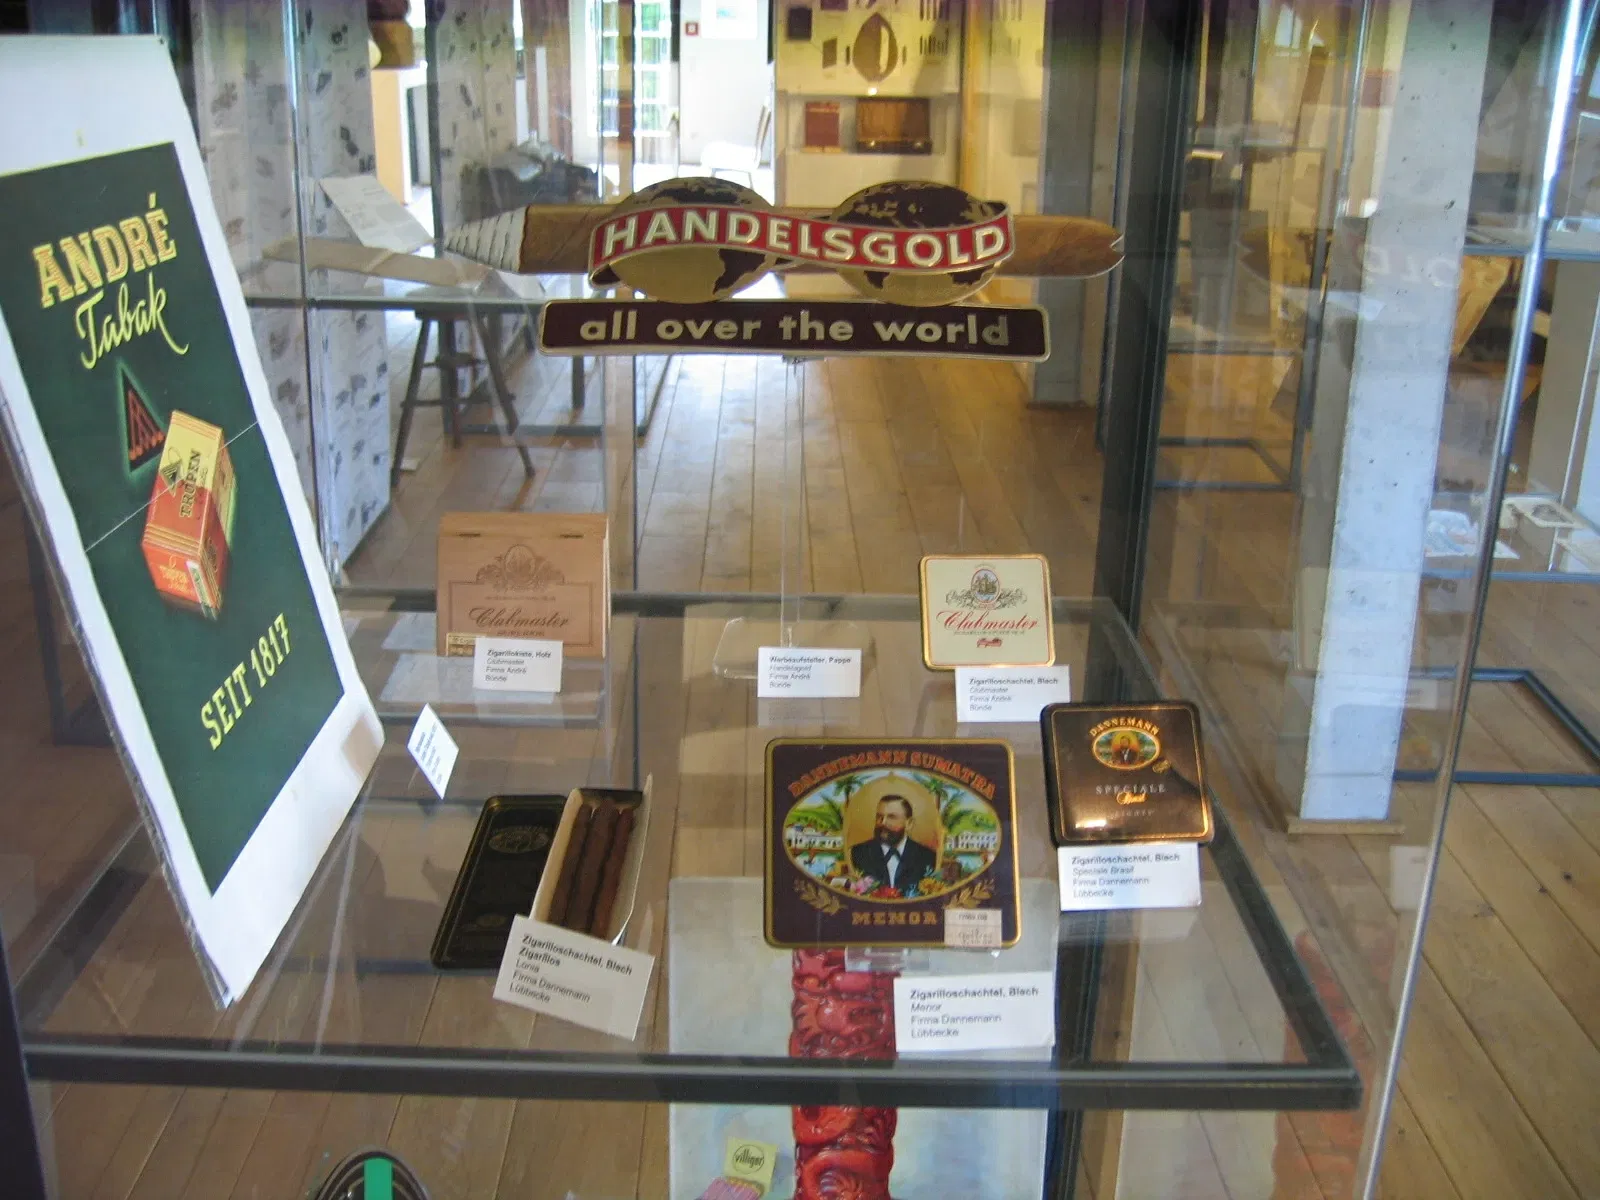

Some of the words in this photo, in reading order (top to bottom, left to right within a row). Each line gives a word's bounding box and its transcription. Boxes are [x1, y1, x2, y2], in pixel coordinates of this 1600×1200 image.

[602, 210, 1005, 267] HANDELSGOLD
[32, 192, 177, 309] ANDRÉ
[76, 271, 190, 370] Tabak
[579, 310, 638, 341] all
[656, 318, 761, 340] over
[779, 310, 854, 341] the
[873, 313, 1009, 346] world
[468, 606, 570, 628] Clubmaster
[936, 611, 1038, 630] Clubmaster
[829, 656, 852, 664] Pappe
[201, 661, 253, 751] SEIT
[250, 613, 291, 688] 1817
[1037, 677, 1059, 685] Blech
[1089, 716, 1160, 737] DANNEMANN
[788, 750, 905, 798] DANNEMANN
[910, 751, 996, 800] SUMATRA
[1096, 783, 1167, 796] SPECIALE
[1154, 853, 1180, 862] Blech
[852, 912, 937, 926] MENOR
[518, 946, 561, 967] Zigarillos
[521, 933, 604, 968] Zigarilloschachtel,
[605, 959, 633, 976] Blech
[512, 970, 538, 985] Firma
[539, 976, 592, 1004] Dannemann
[909, 987, 1006, 1000] Zigarilloschachtel,
[1008, 986, 1040, 997] Blech
[910, 1002, 942, 1013] Menor
[910, 1015, 939, 1025] Firma
[941, 1013, 1002, 1025] Dannemann
